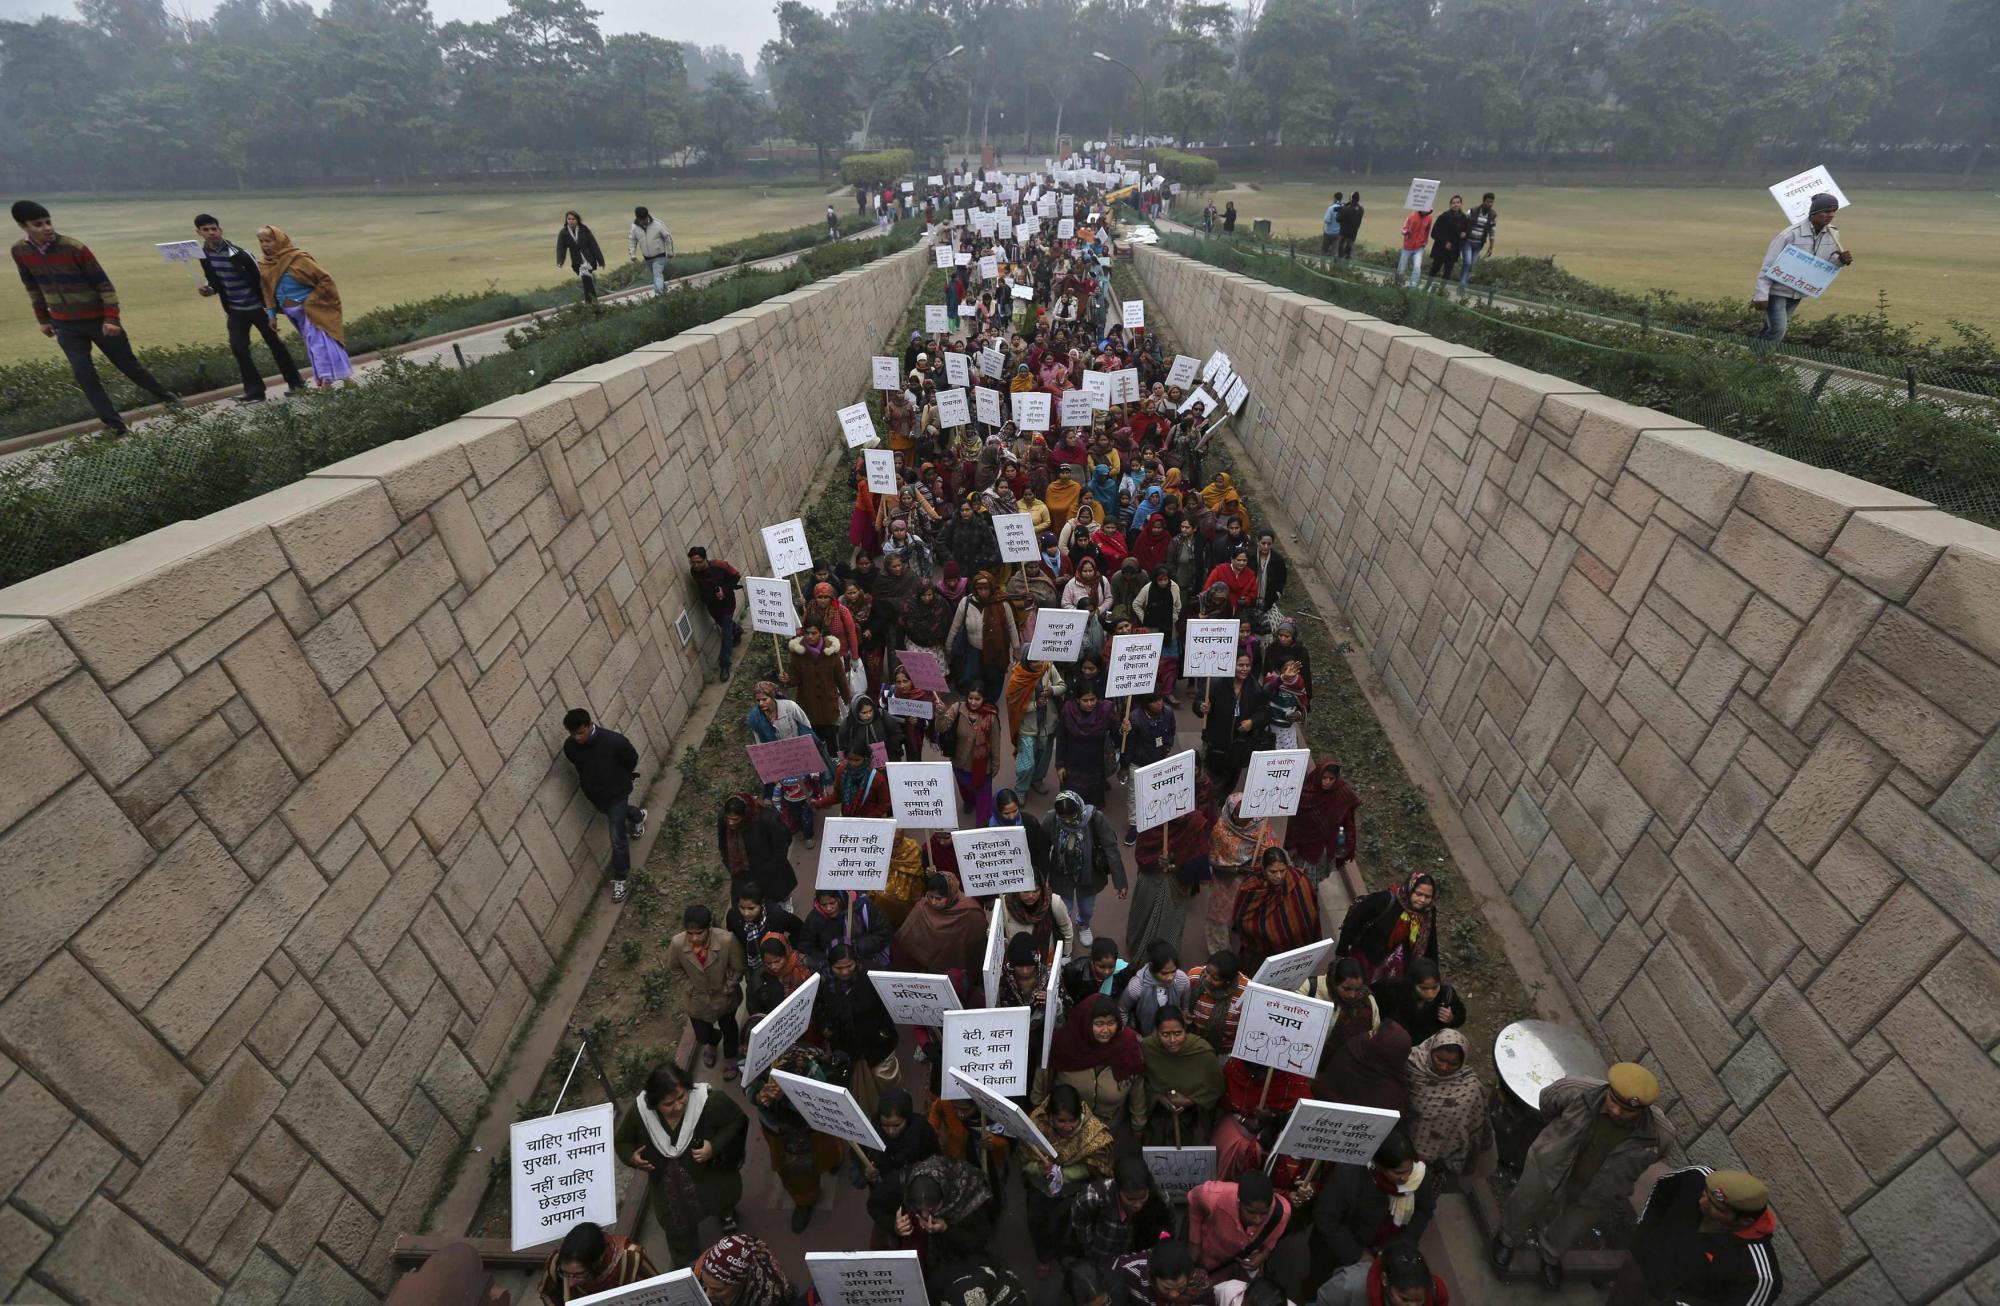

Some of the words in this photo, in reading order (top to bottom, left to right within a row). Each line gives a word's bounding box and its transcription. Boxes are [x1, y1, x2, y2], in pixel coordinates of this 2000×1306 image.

[1118, 654, 1127, 662] की
[1148, 651, 1157, 659] की
[1267, 769, 1291, 778] न्याय
[927, 778, 938, 787] की
[1152, 773, 1184, 790] सम्मान
[914, 788, 930, 796] नारी
[932, 799, 943, 808] की
[908, 809, 942, 817] अधिकारी
[839, 835, 859, 843] हिंसा
[971, 839, 1011, 850] महिलाओं
[829, 846, 857, 854] सम्मान
[860, 845, 885, 855] चाहिए
[963, 852, 976, 860] की
[1009, 847, 1021, 855] की
[837, 859, 861, 867] जीवन
[858, 869, 882, 878] चाहिए
[972, 880, 995, 888] पक्की
[999, 877, 1024, 885] आदत
[893, 990, 938, 1001] प्रतिष्ठा
[1266, 1000, 1280, 1008] हमें
[1283, 1004, 1310, 1018] चाहिए
[1268, 1013, 1303, 1030] न्याय
[962, 1029, 985, 1041] बेटी,
[990, 1029, 1013, 1039] बहन
[987, 1043, 1010, 1053] माता
[960, 1061, 994, 1073] परिवार
[999, 1059, 1013, 1071] की
[982, 1075, 1016, 1085] विधाता
[1315, 1117, 1344, 1128] हिंसा
[1300, 1125, 1338, 1134] सम्मान
[1342, 1131, 1376, 1140] चाहिए
[526, 1134, 563, 1151] चाहिए
[567, 1126, 601, 1142] गरिमा
[1308, 1136, 1340, 1145] जीवन
[1294, 1142, 1329, 1151] आधार
[1333, 1147, 1366, 1156] चाहिए
[522, 1153, 561, 1175] सुरक्षा,
[567, 1142, 605, 1160] सम्मान
[531, 1176, 554, 1193] नहीं
[558, 1169, 594, 1187] चाहिए
[538, 1188, 587, 1209] छेड़छाड़
[541, 1206, 585, 1227] अपमान
[839, 1270, 868, 1278] नारी
